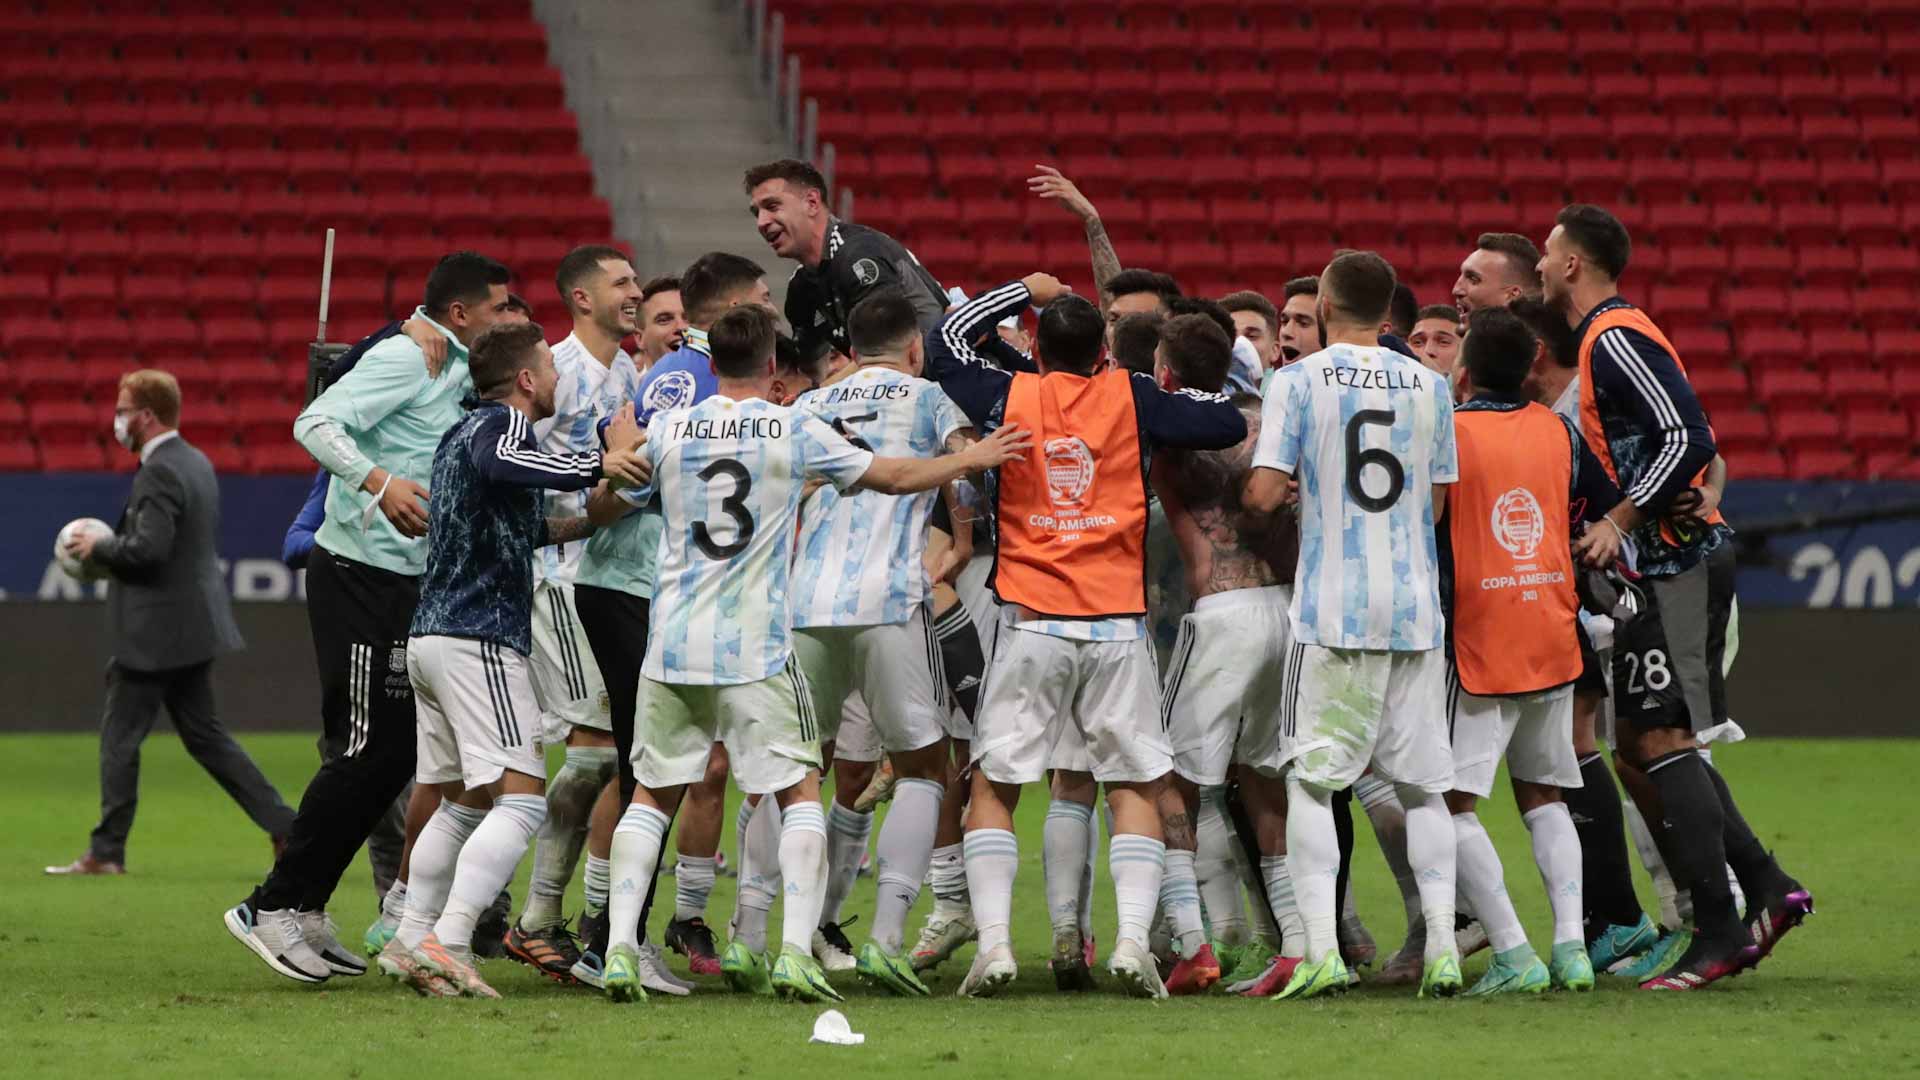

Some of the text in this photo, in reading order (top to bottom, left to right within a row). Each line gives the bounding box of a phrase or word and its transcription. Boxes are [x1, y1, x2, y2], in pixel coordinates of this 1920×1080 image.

[1322, 366, 1424, 392] PEZZELLA
[826, 384, 910, 404] PAREDES
[672, 418, 782, 441] TAGLIAFICO
[1344, 409, 1405, 513] 6
[691, 458, 755, 561] 3
[1058, 515, 1117, 531] AMERICA
[1481, 571, 1566, 590] COPA AMERICA
[1624, 648, 1671, 692] 28
[384, 688, 409, 699] YPF
